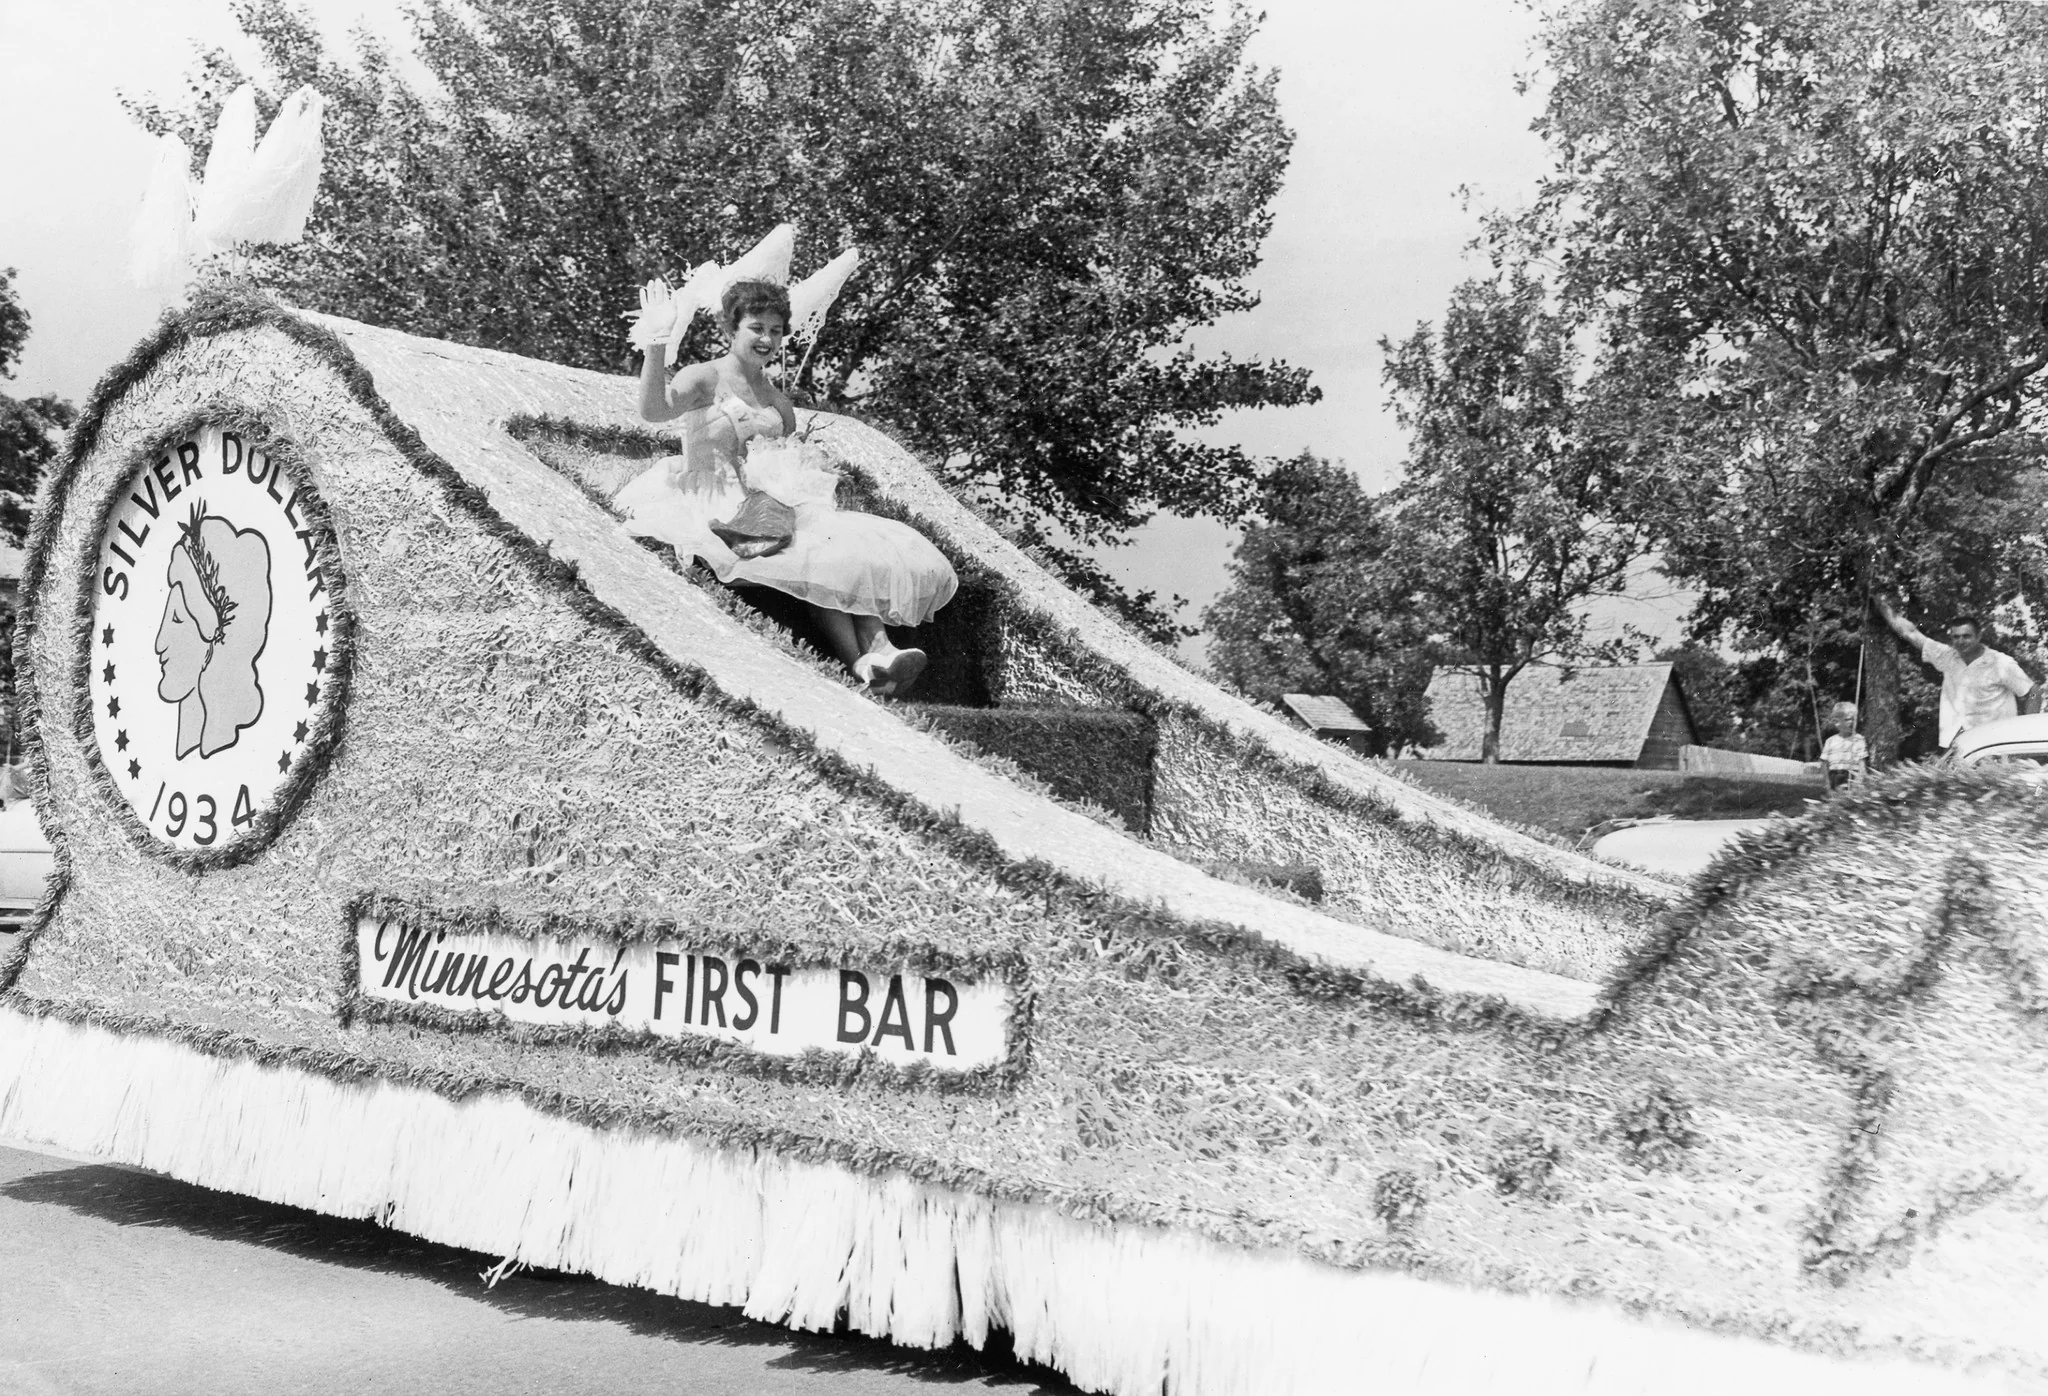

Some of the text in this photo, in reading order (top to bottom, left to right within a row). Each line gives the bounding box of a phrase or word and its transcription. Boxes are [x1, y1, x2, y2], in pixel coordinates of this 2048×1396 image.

[103, 440, 204, 602] SILVER
[149, 781, 256, 846] 1934
[374, 921, 957, 1056] Minnesota's FIRST BAR
